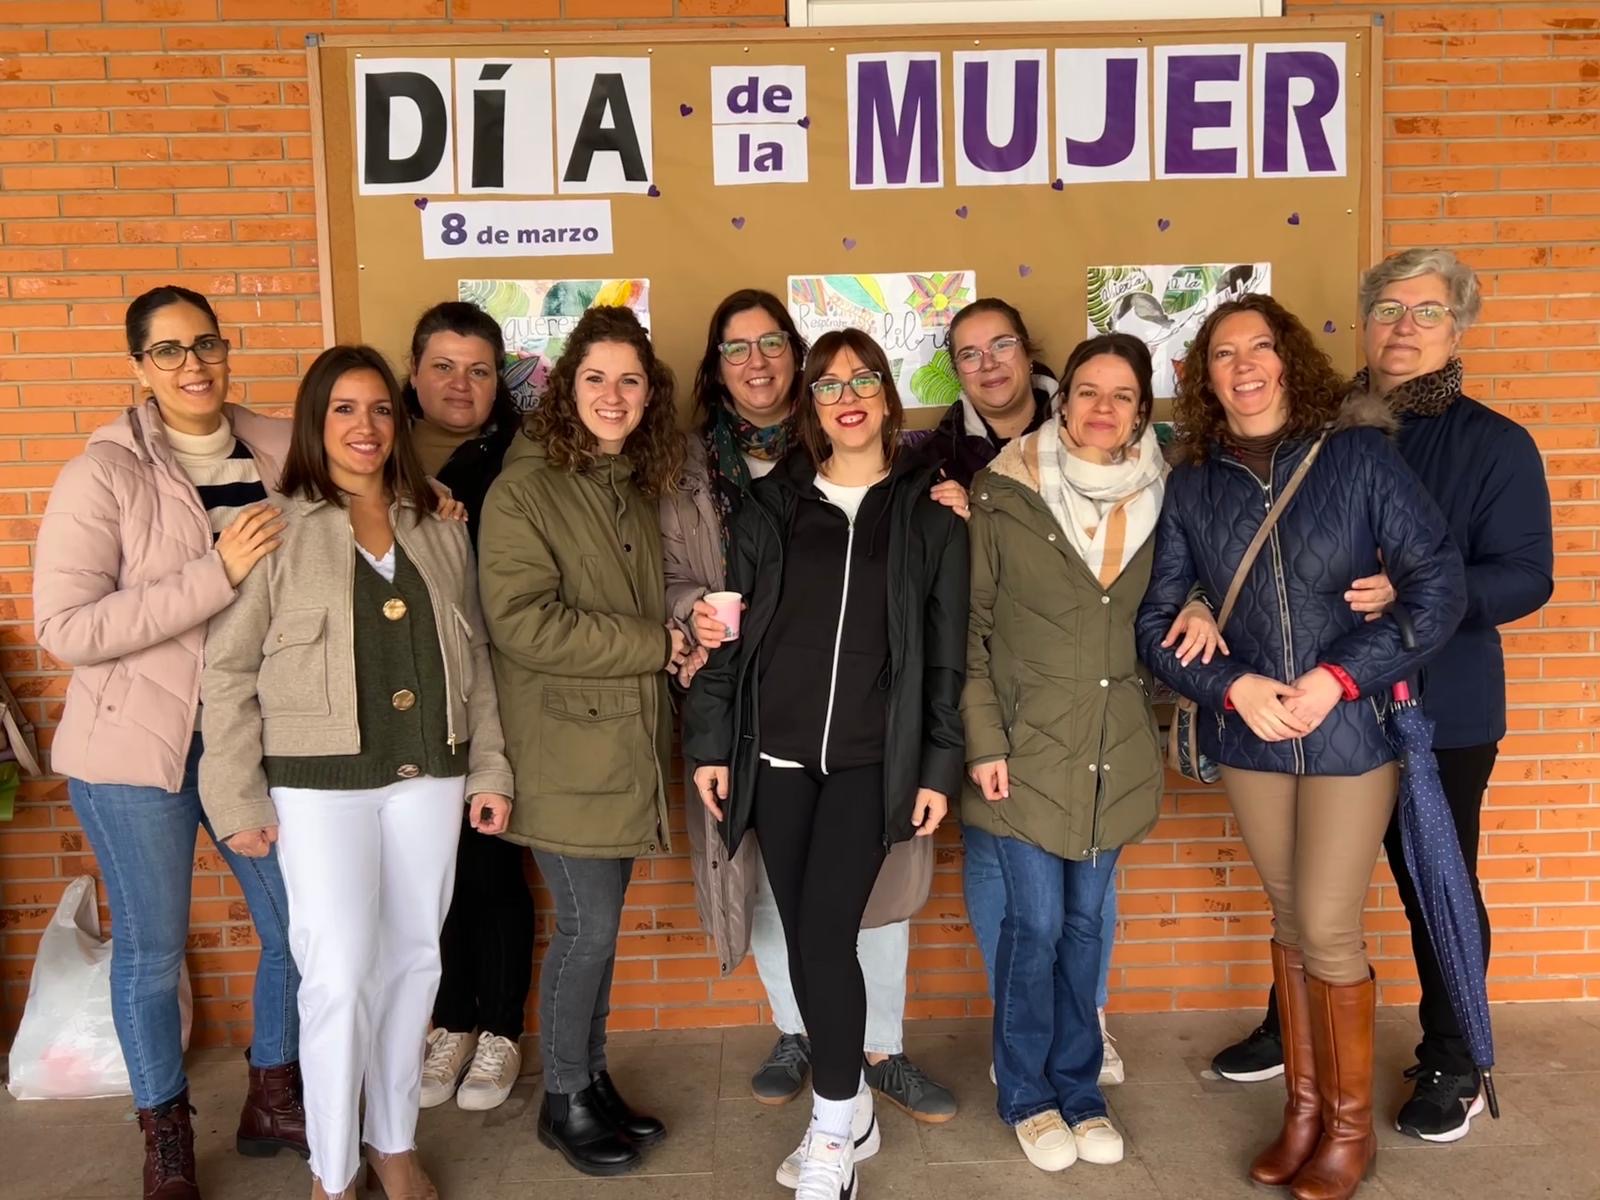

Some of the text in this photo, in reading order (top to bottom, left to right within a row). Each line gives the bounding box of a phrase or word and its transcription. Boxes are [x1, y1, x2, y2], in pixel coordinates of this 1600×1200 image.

[726, 76, 794, 115] de
[364, 63, 649, 189] DÍA
[854, 50, 1340, 186] MUJER
[737, 133, 784, 173] la
[440, 212, 599, 246] 8 de marzo
